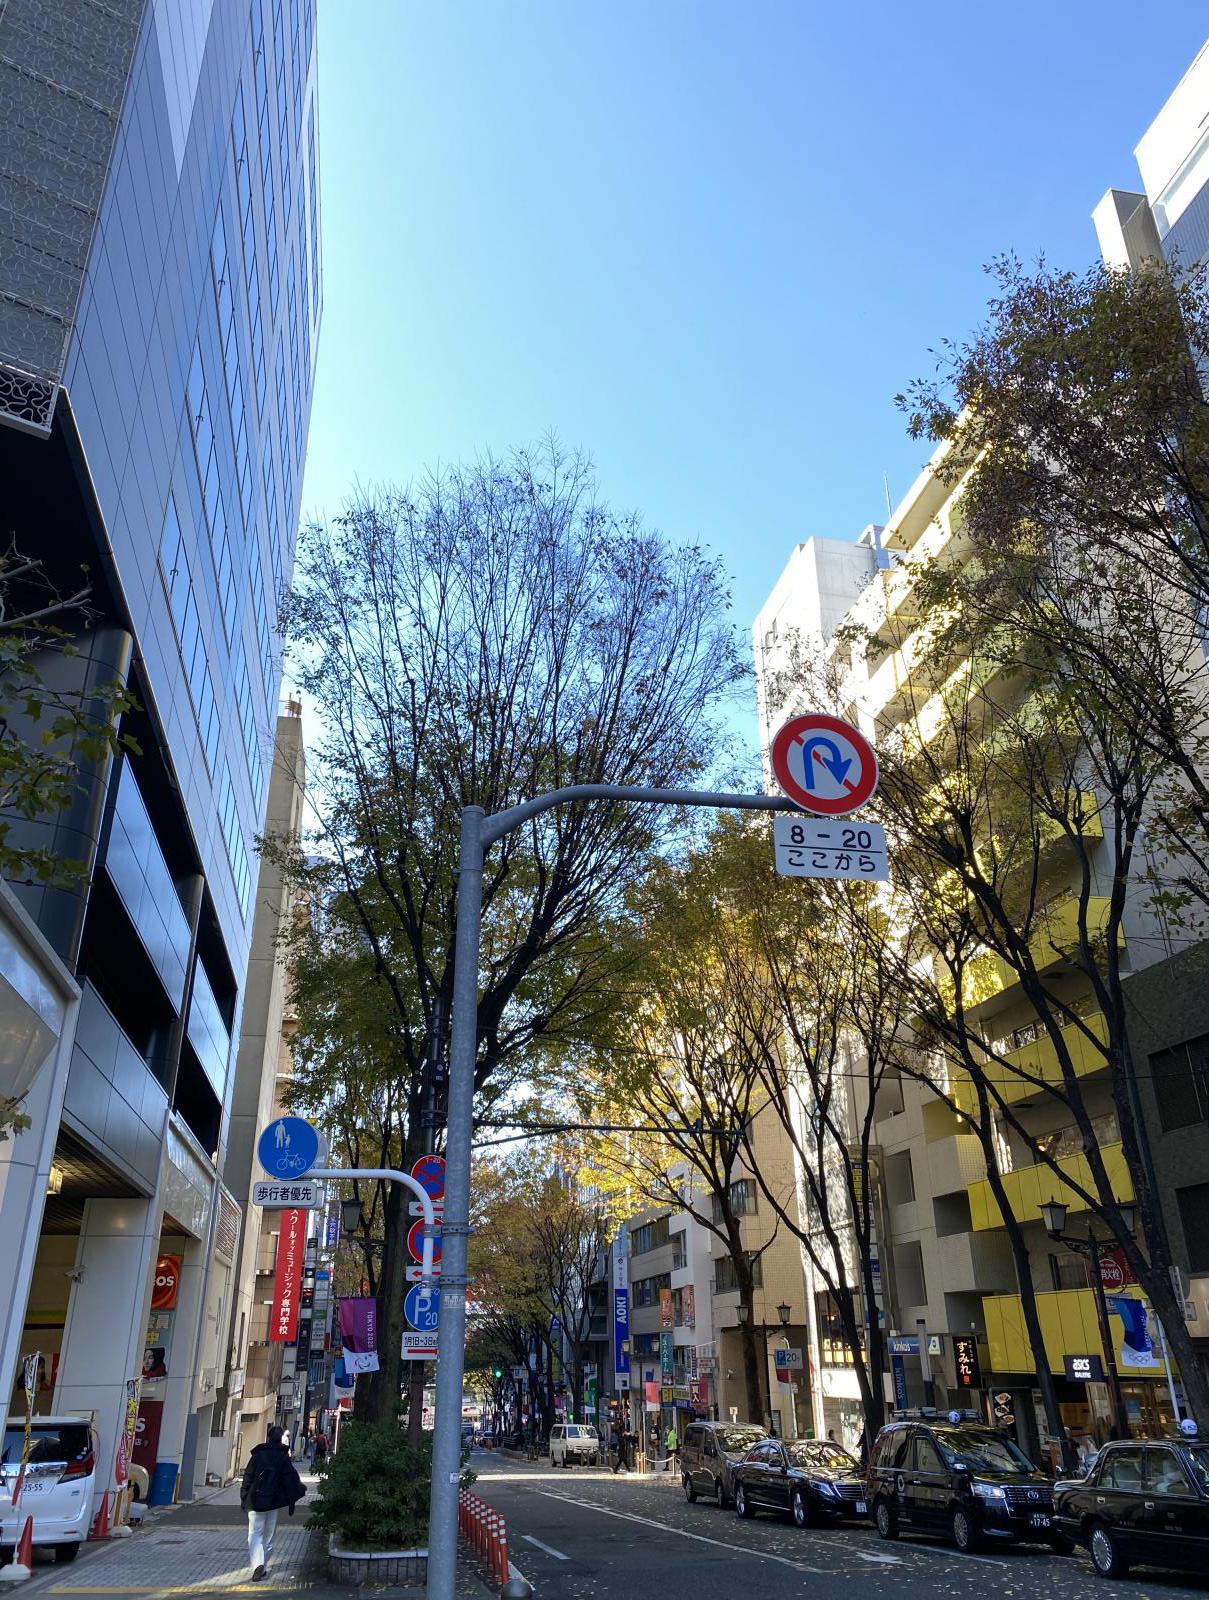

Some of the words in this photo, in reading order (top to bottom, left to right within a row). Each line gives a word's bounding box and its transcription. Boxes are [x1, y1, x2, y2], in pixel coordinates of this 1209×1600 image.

[842, 829, 872, 849] 20
[788, 850, 876, 873] ここから
[257, 1187, 312, 1201] 歩行者優先
[414, 1296, 432, 1325] P
[425, 1312, 438, 1326] 20
[616, 1296, 627, 1324] AOKI
[956, 1341, 972, 1375] すみれ
